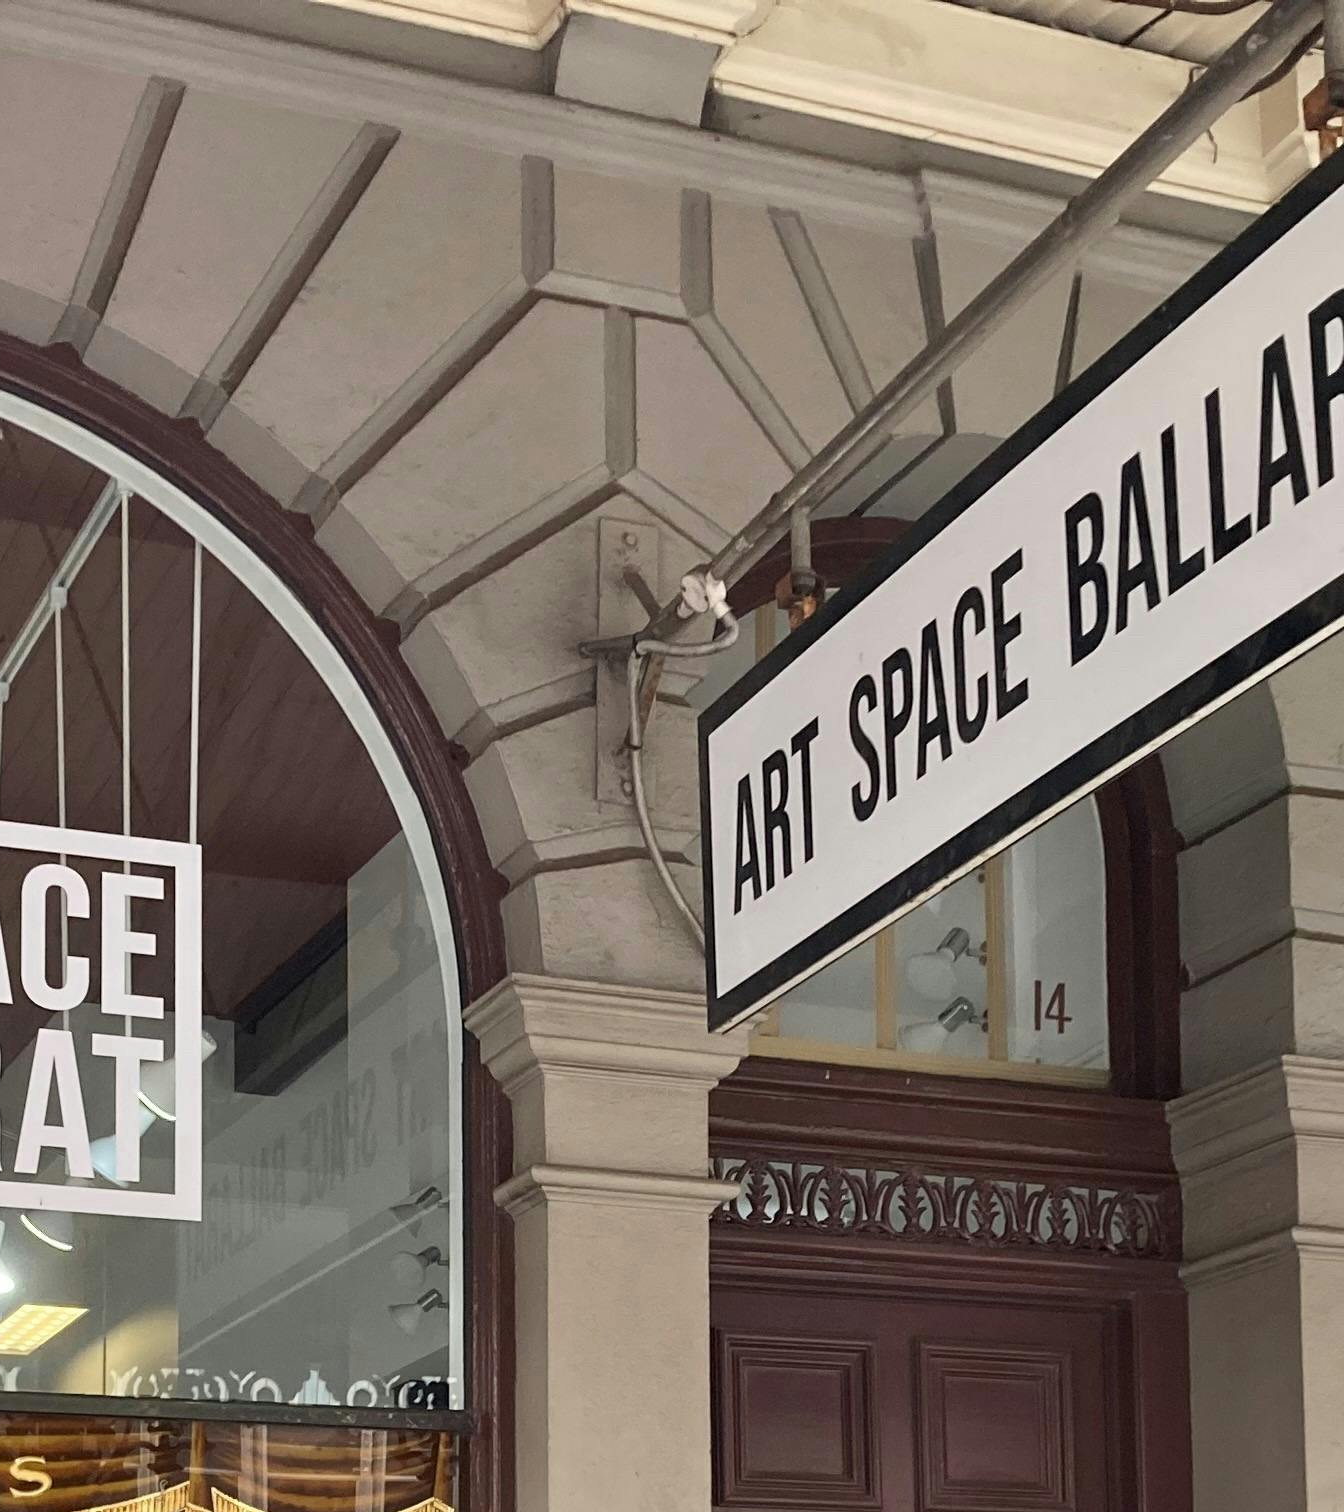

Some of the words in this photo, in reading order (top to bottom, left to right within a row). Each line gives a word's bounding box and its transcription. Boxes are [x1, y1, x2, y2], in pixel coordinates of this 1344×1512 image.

[733, 716, 820, 917] ART
[847, 547, 1031, 823] SPACE
[1034, 979, 1072, 1034] 14
